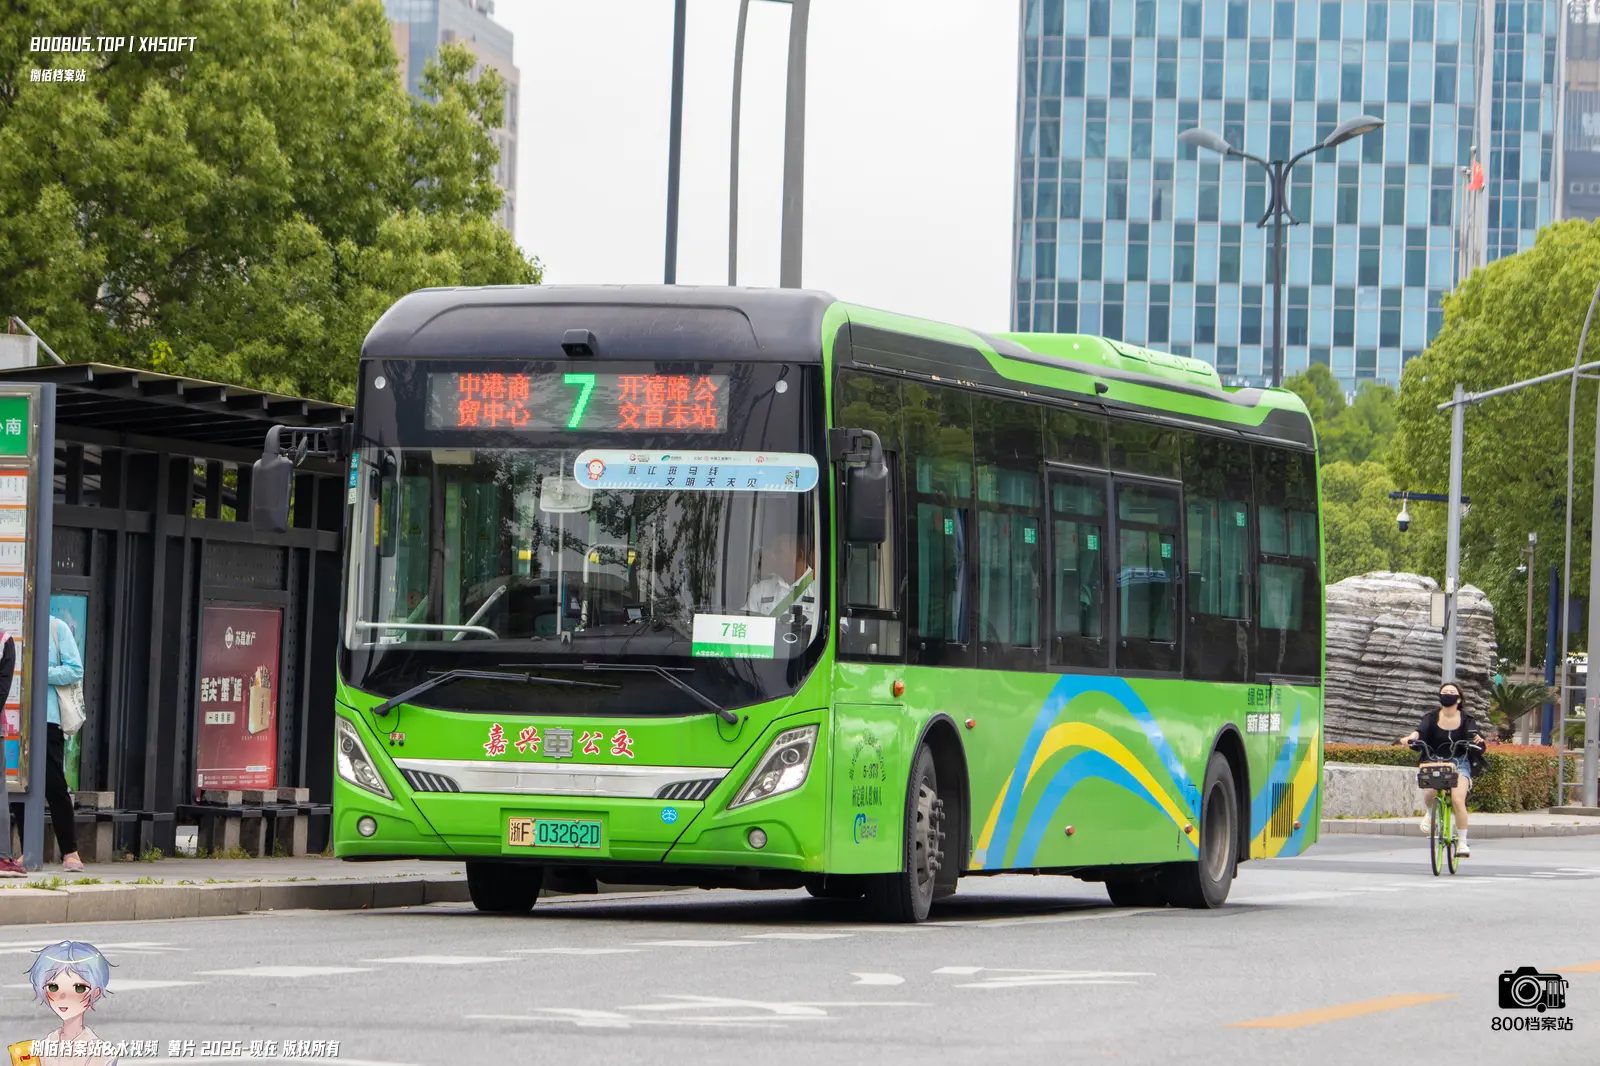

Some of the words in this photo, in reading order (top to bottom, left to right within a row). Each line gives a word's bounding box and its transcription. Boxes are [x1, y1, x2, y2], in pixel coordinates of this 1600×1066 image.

[564, 373, 595, 429] 7
[617, 401, 718, 429] 交首末站
[721, 622, 748, 639] 7路
[1246, 713, 1281, 733] 新能源
[483, 723, 541, 756] 嘉兴
[578, 729, 634, 758] 公交
[511, 822, 531, 842] 浙F
[539, 823, 600, 845] 03262D
